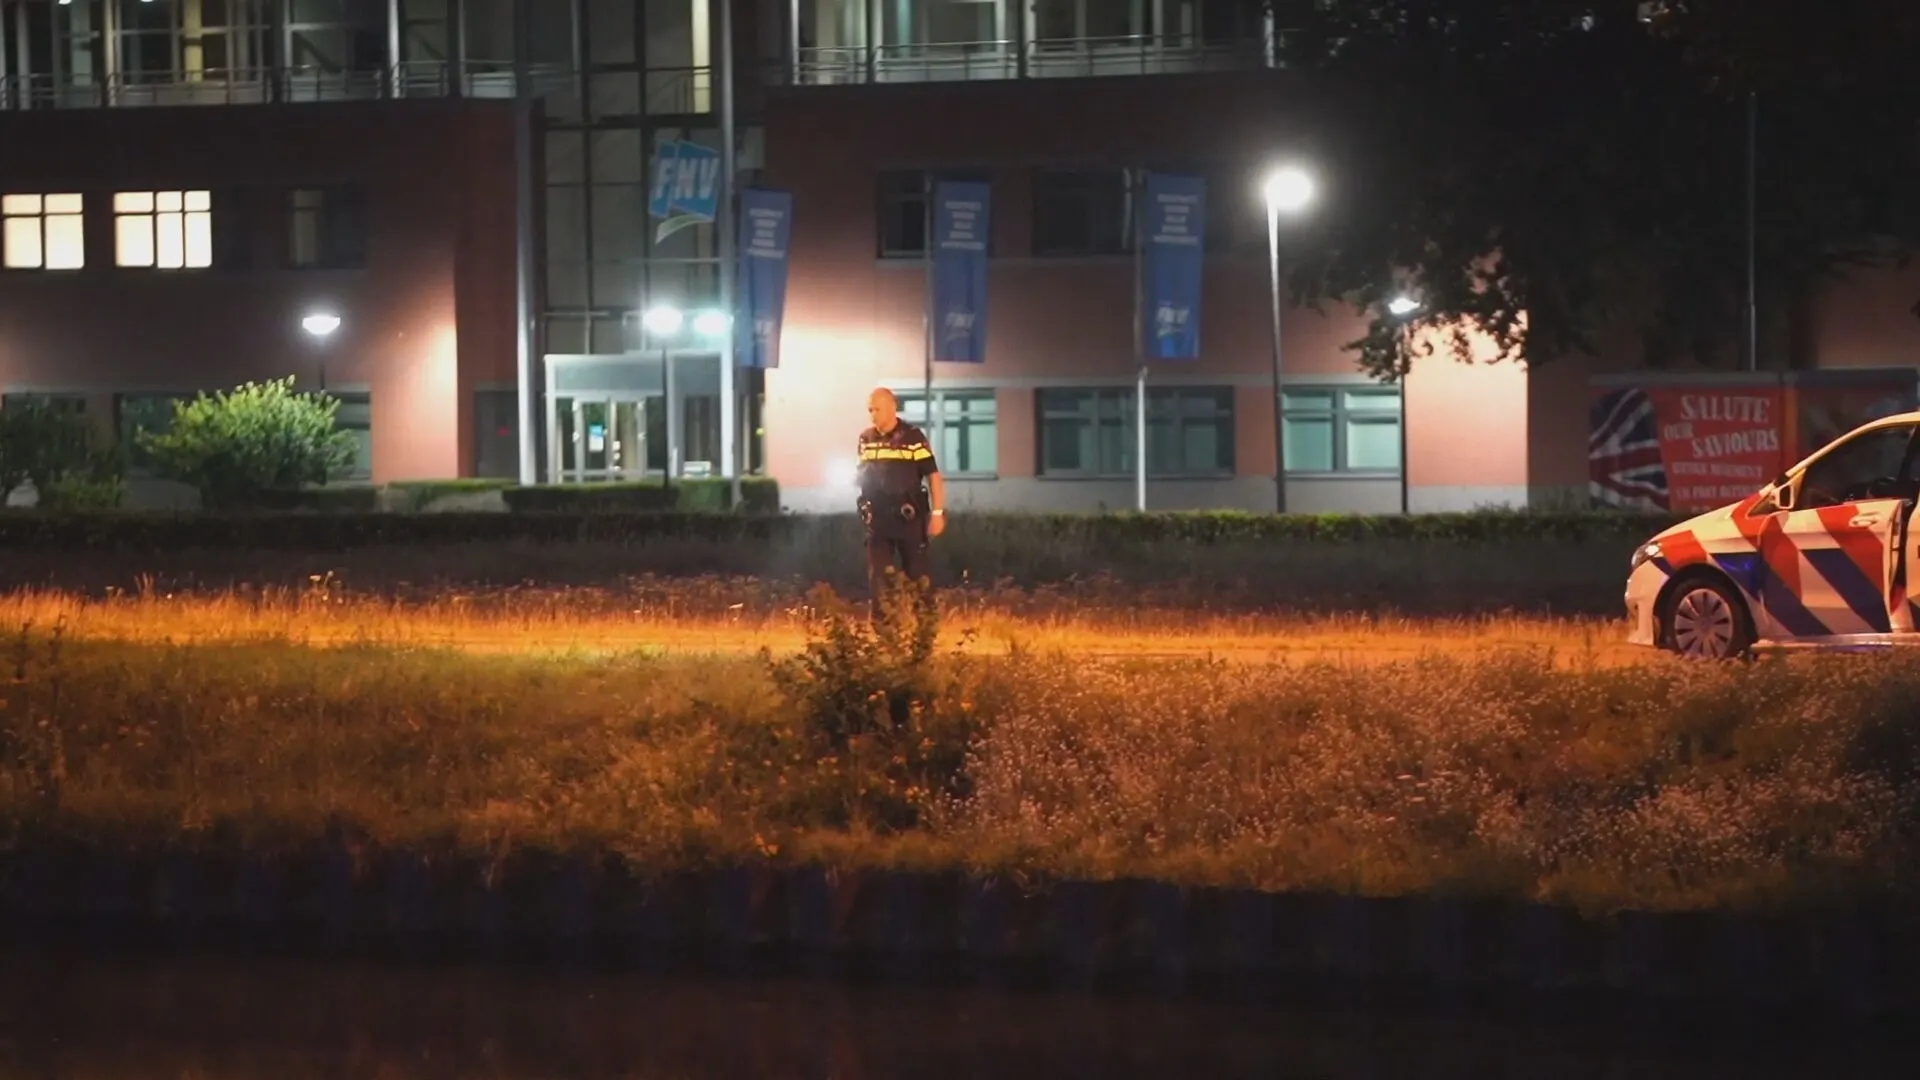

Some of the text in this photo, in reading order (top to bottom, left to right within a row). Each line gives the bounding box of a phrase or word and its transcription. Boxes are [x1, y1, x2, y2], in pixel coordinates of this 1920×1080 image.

[654, 157, 719, 200] FNV
[1681, 394, 1770, 423] SALUTE
[1664, 422, 1694, 440] OUR
[1692, 429, 1779, 458] SAVIOURS
